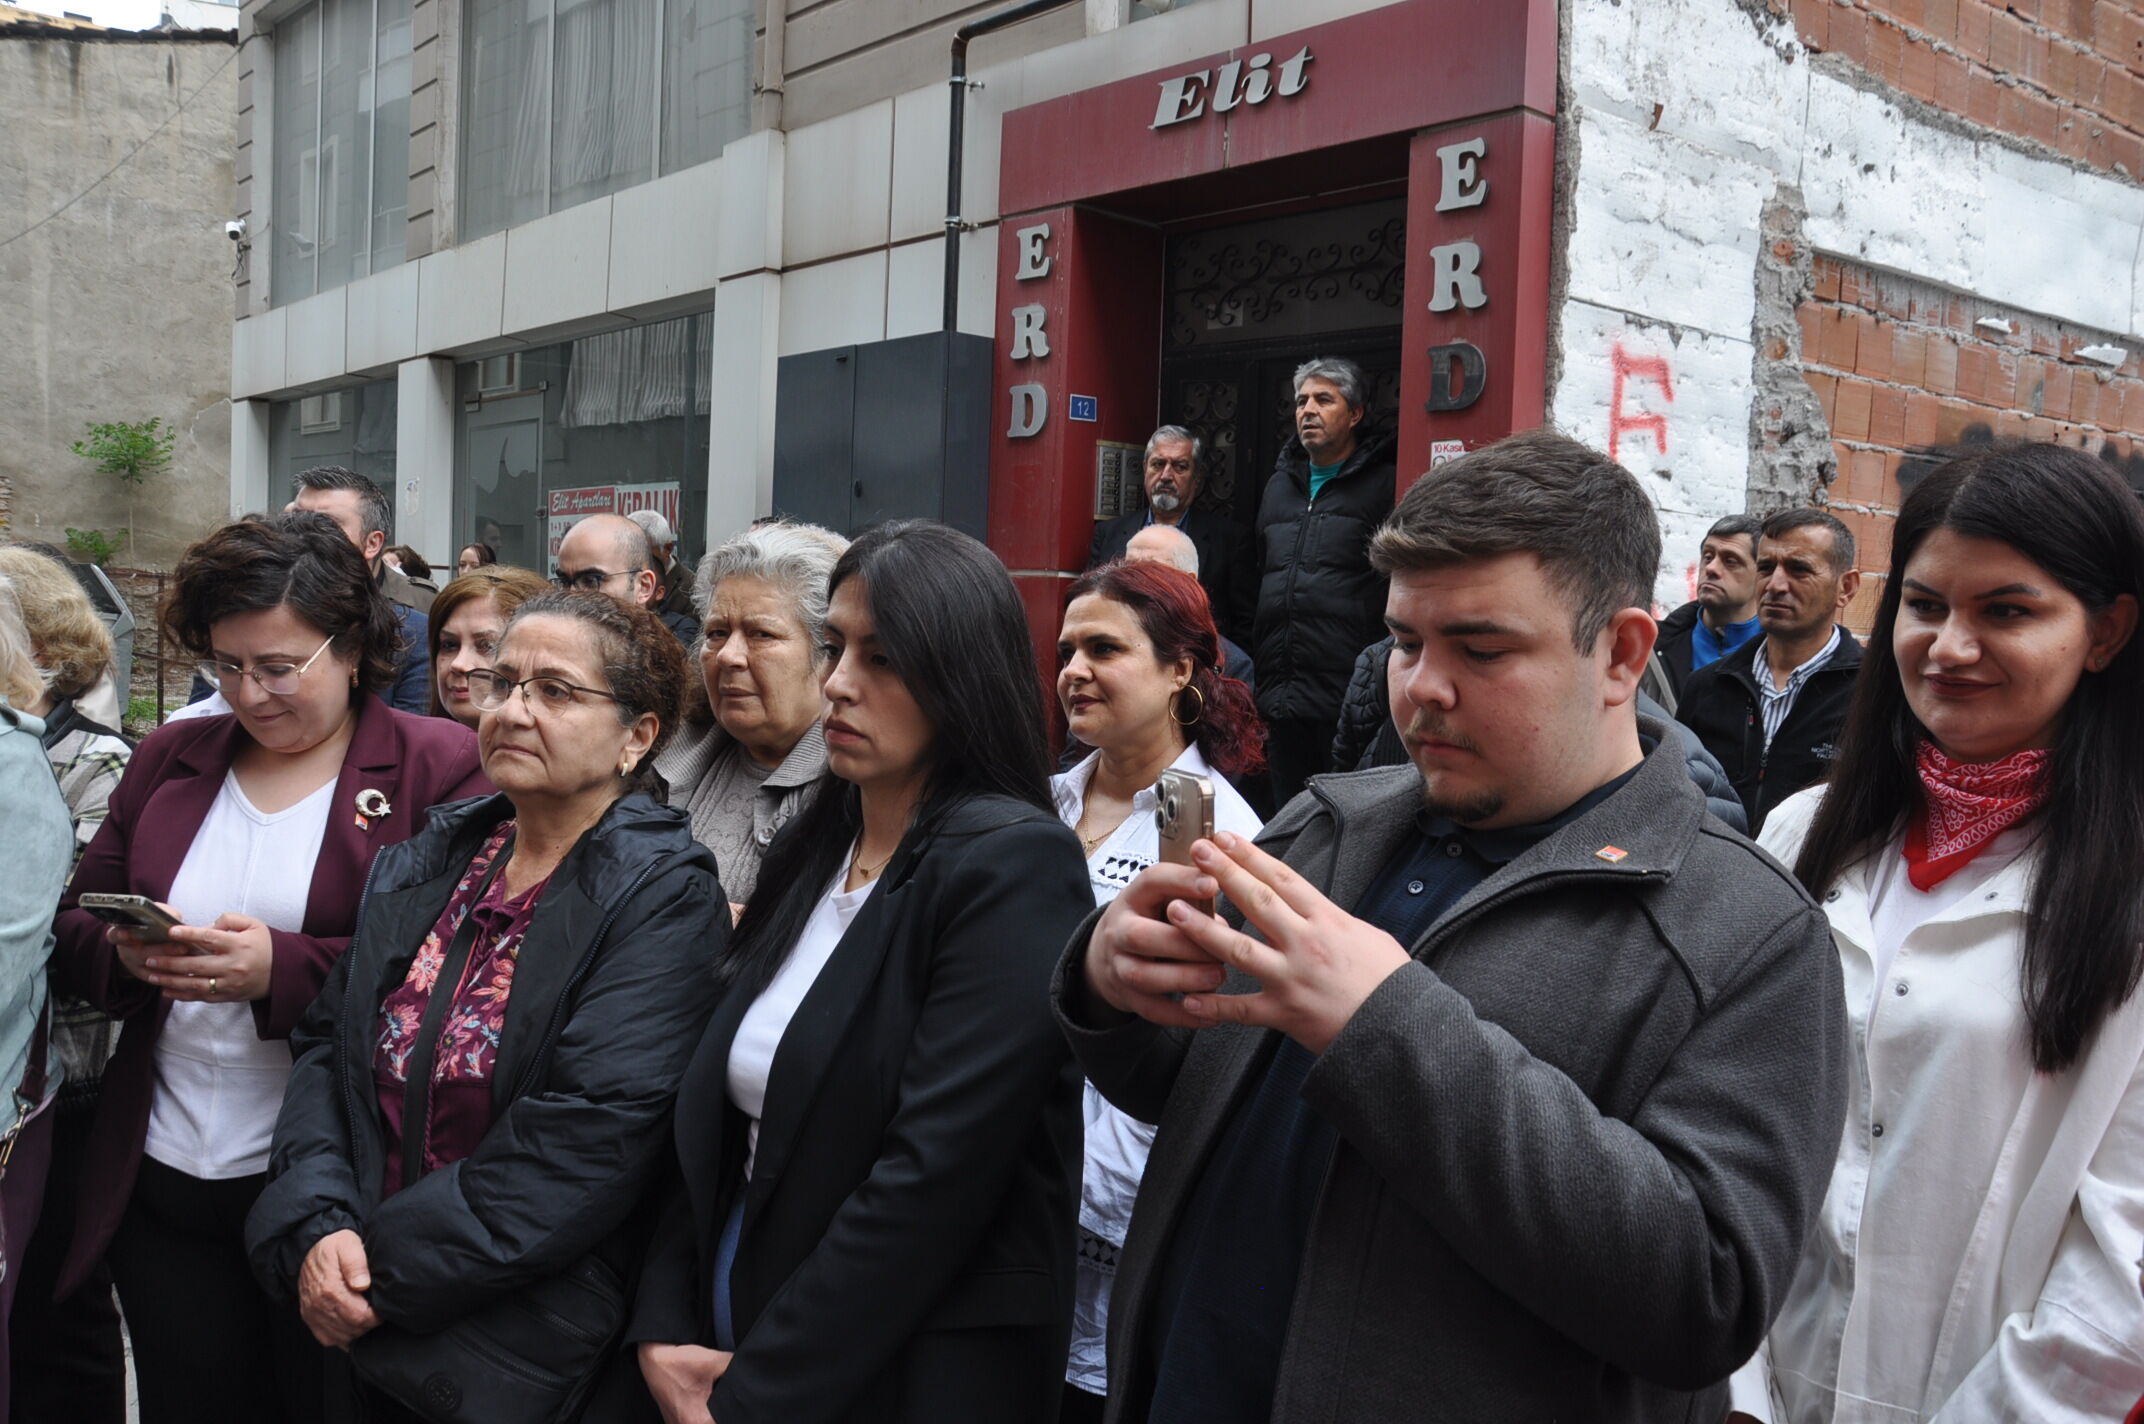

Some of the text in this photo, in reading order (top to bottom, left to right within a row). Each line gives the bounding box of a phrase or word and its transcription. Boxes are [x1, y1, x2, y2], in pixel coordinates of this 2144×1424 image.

[1148, 46, 1314, 130] Elit
[1425, 137, 1488, 413] ERD
[1007, 223, 1052, 438] ERD
[1077, 401, 1090, 416] 12
[1434, 444, 1442, 454] 10
[552, 492, 570, 512] Elit
